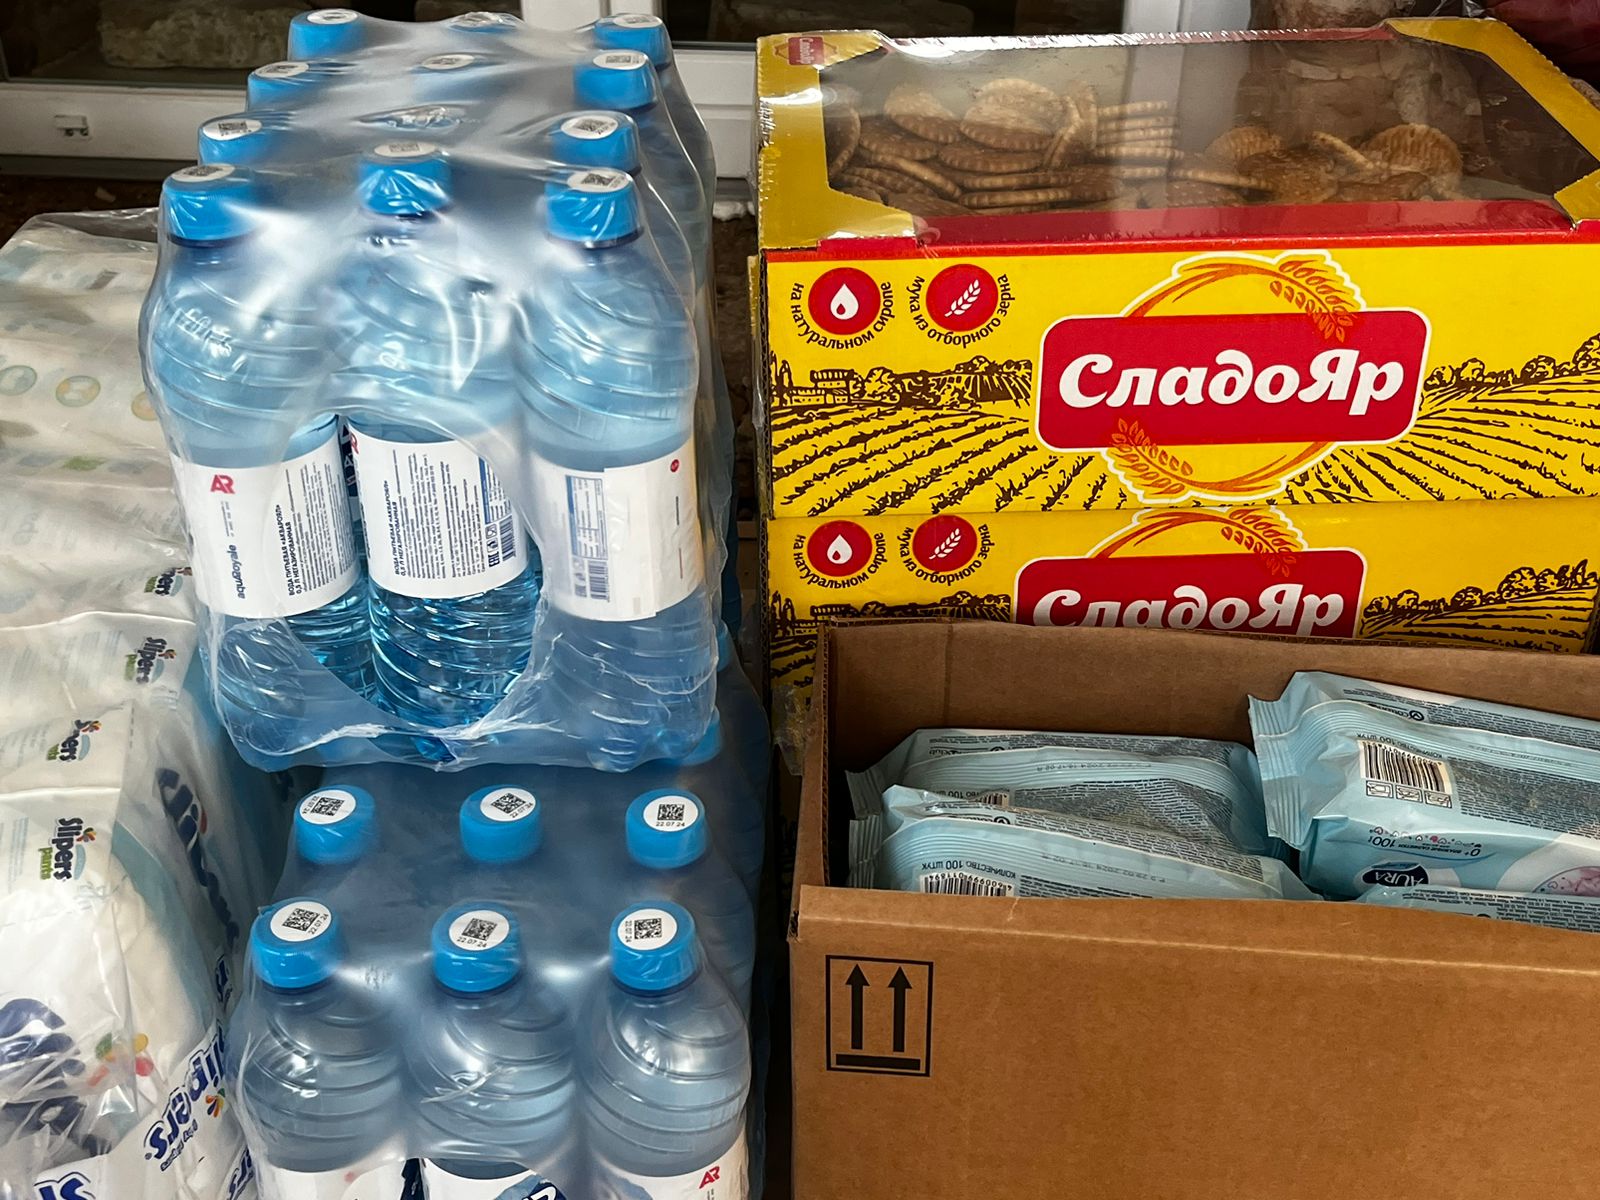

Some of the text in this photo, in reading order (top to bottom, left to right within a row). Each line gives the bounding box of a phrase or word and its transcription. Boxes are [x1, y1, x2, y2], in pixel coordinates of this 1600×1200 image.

[791, 281, 896, 350] на натуральном сиропе
[912, 315, 929, 331] из
[927, 317, 1001, 349] отборного
[997, 273, 1015, 317] зерна
[1058, 349, 1404, 416] СладоЯр
[210, 474, 236, 494] AR
[281, 546, 292, 579] ПИТЬЕВАЯ
[792, 533, 888, 589] на натуральном сиропе
[904, 558, 917, 574] из
[915, 560, 982, 586] отборного
[978, 523, 995, 560] зерна
[287, 580, 296, 596] ВОДА
[136, 637, 168, 684] Slipers
[38, 847, 54, 881] pants
[51, 818, 84, 880] Slipers
[921, 860, 1016, 879] КОЛИЧЕСТВО 100 ШТУК
[1375, 872, 1425, 887] AURA
[698, 1166, 721, 1189] AR
